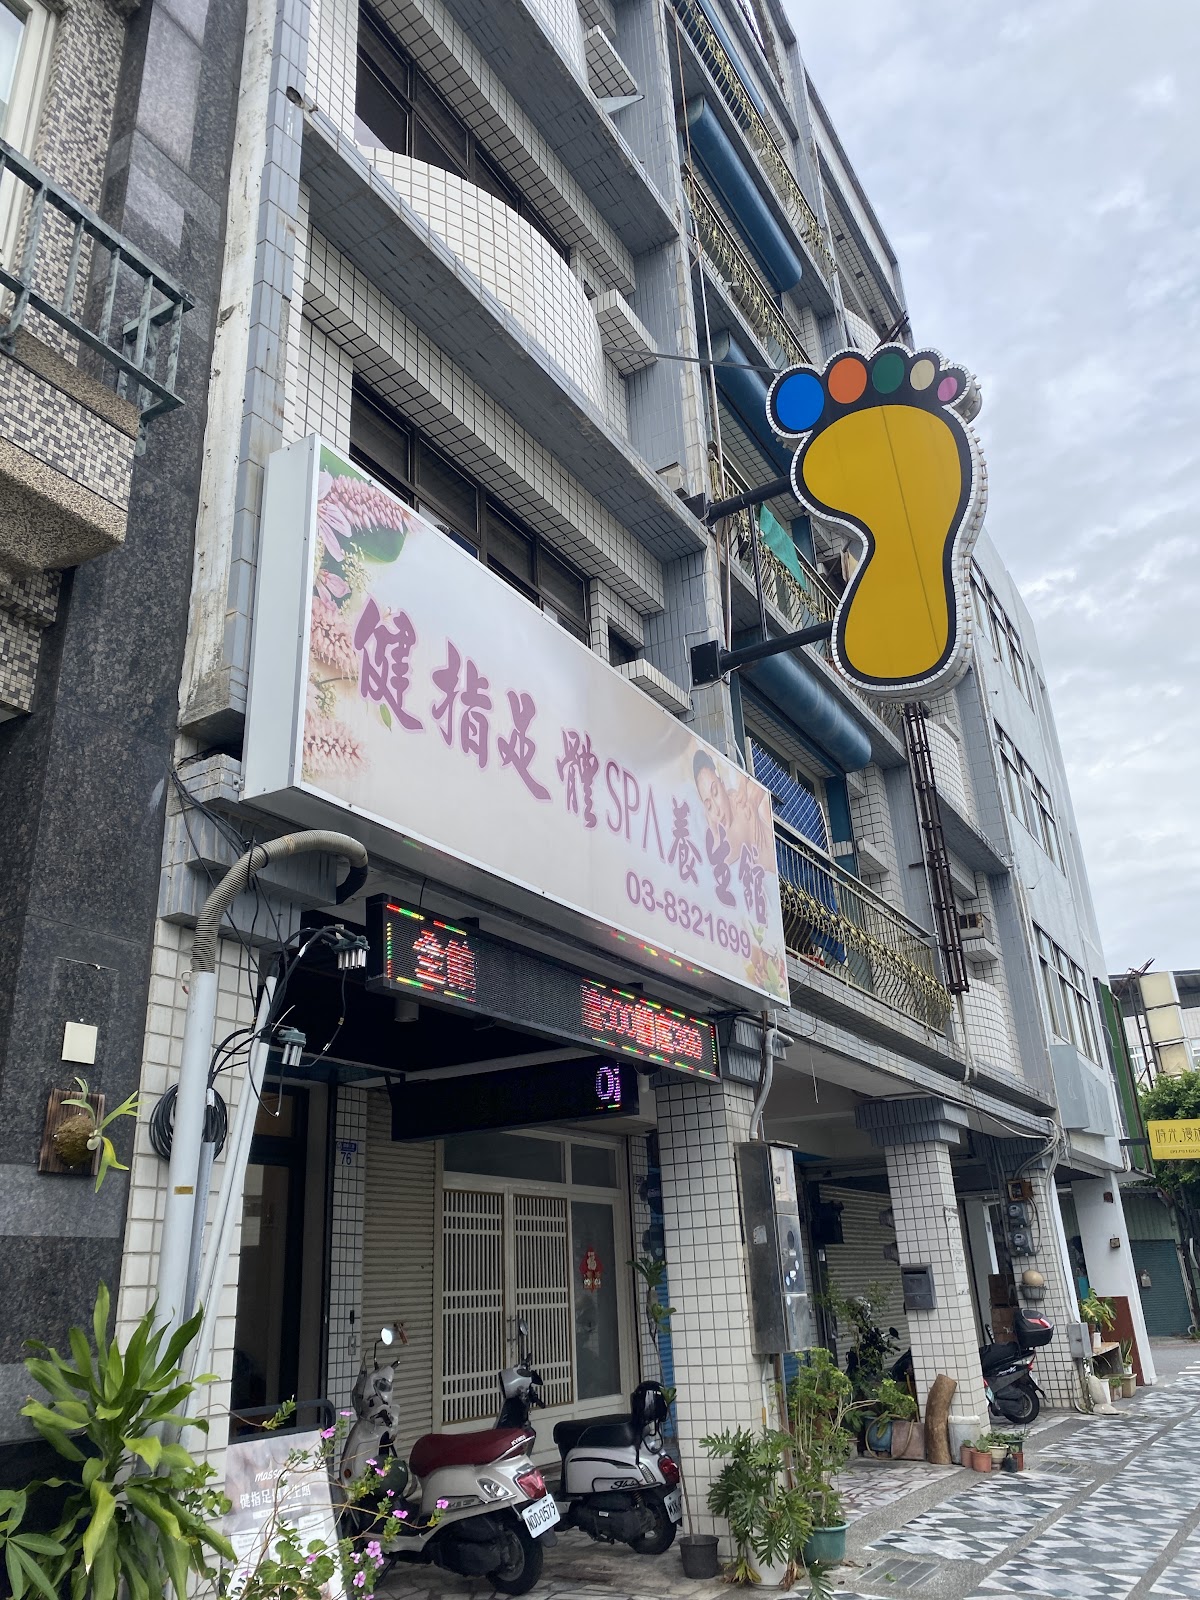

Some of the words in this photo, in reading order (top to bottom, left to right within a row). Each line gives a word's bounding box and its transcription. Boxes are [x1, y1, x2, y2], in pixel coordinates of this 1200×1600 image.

[626, 871, 751, 959] 03-8321699
[341, 1152, 352, 1165] 76
[526, 1502, 556, 1531] NDD-0579
